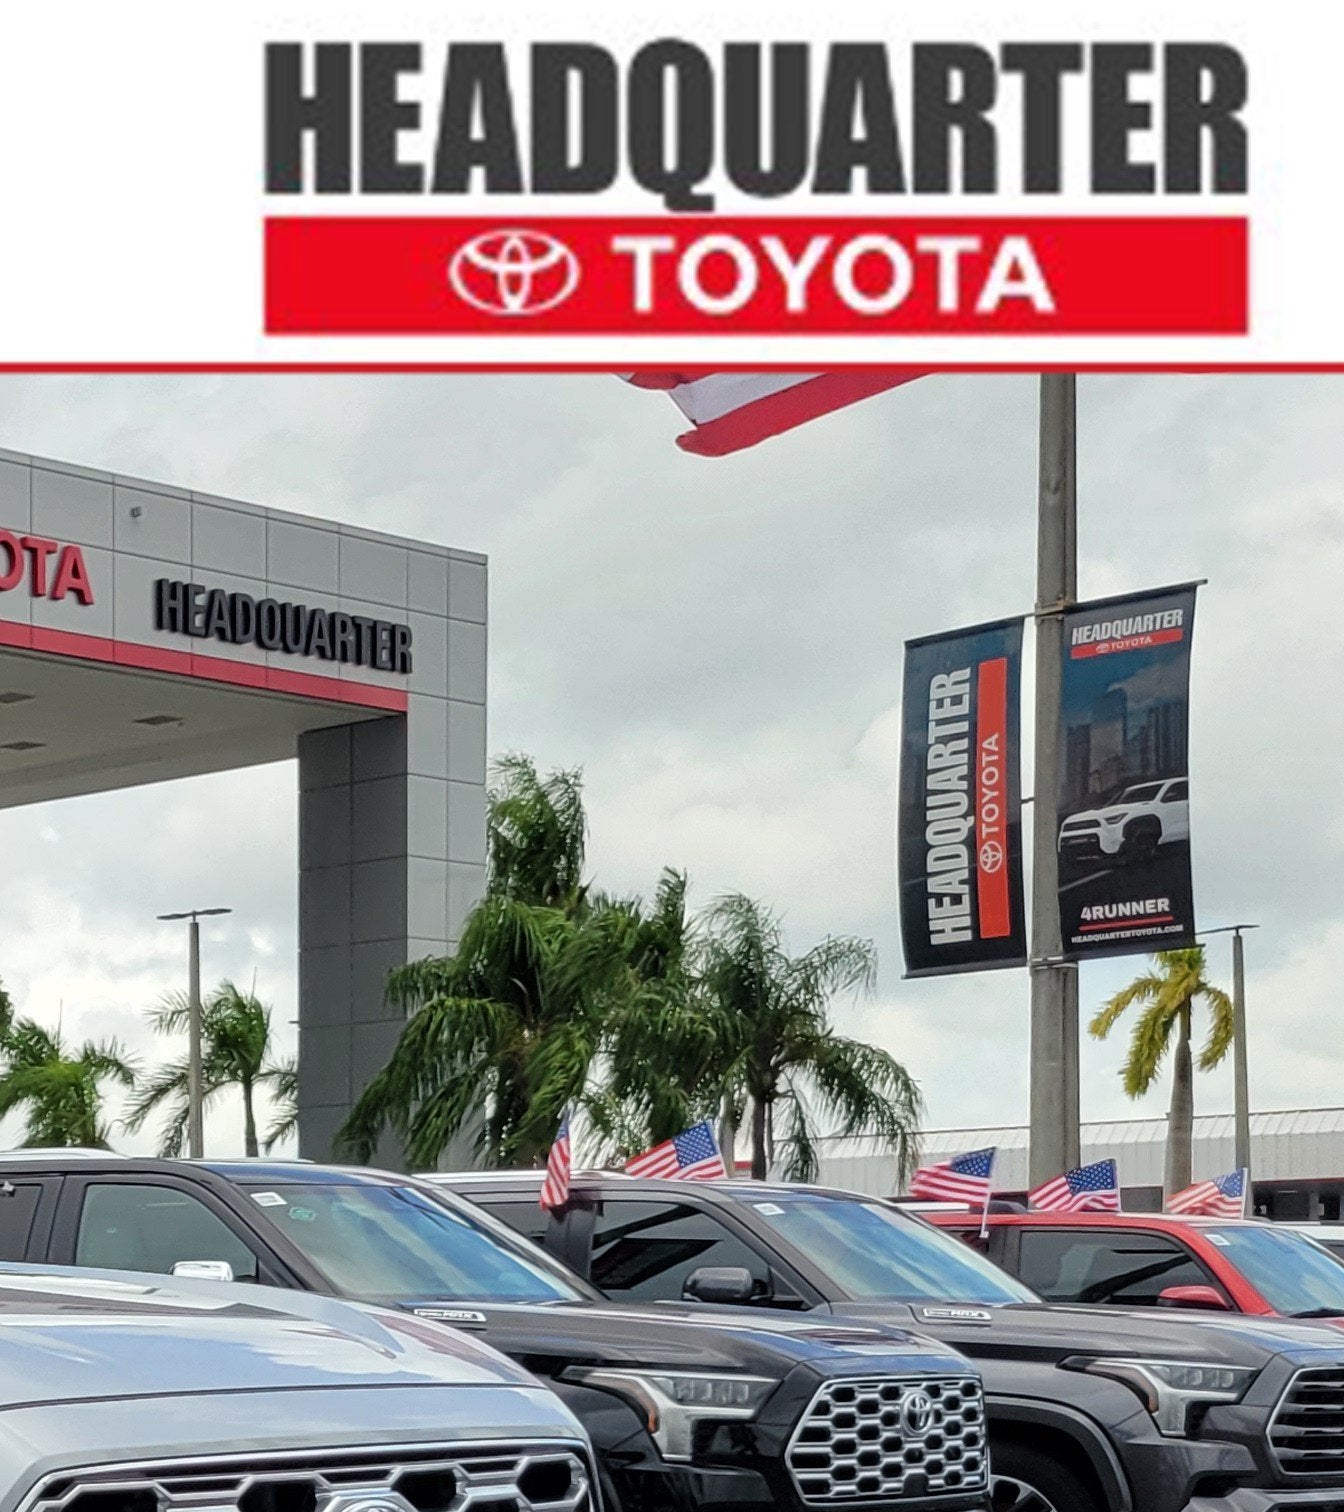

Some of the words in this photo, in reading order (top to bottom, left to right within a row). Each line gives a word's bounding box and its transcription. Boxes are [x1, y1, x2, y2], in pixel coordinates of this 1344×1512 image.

[154, 578, 412, 674] HEADQUARTER
[1072, 608, 1184, 646] HEADQUARTER
[1111, 636, 1152, 650] TOYOTA
[925, 667, 975, 945] HEADQUARTER
[980, 733, 1000, 838] TOYOTA
[1080, 897, 1171, 921] 4RUNNER
